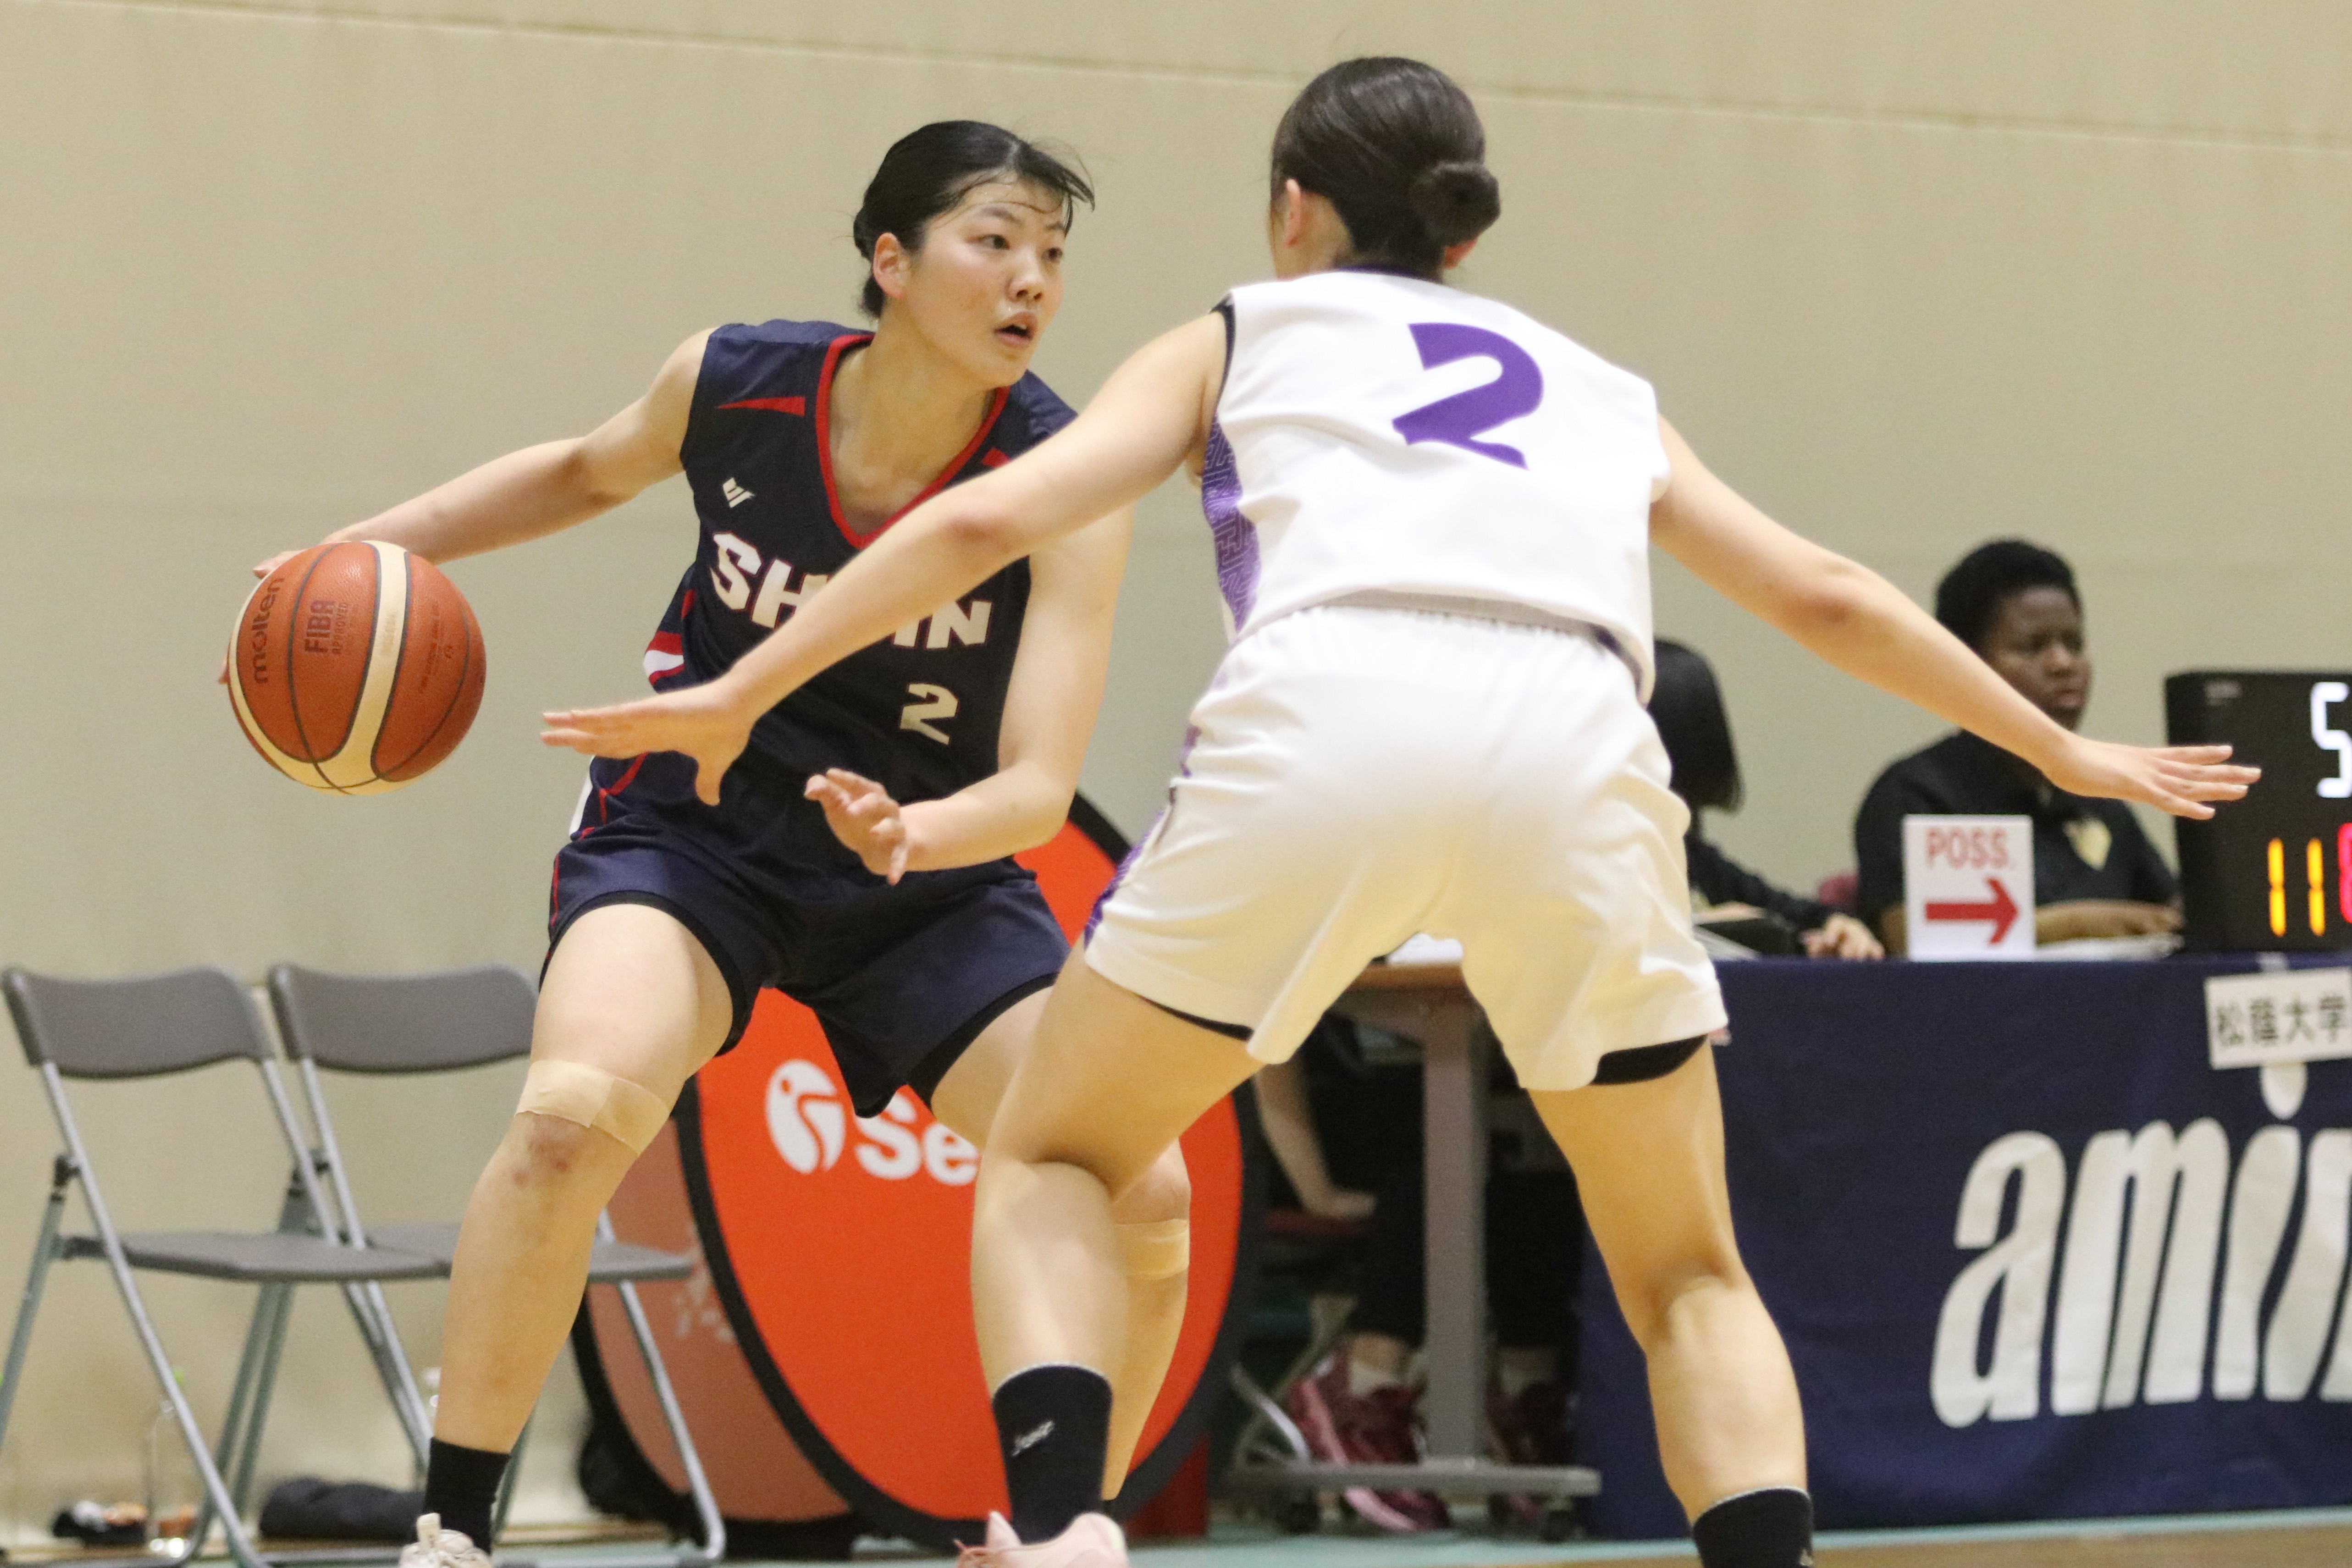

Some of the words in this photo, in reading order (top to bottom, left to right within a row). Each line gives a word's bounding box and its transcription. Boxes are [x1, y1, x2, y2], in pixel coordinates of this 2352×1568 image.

[1392, 322, 1544, 471] 2
[252, 577, 285, 684] molten
[304, 600, 336, 653] FIBA
[331, 602, 348, 655] APPROVED
[710, 531, 992, 648] SHN
[900, 683, 959, 745] 2
[2310, 681, 2352, 798] 5
[2267, 837, 2325, 938] 11
